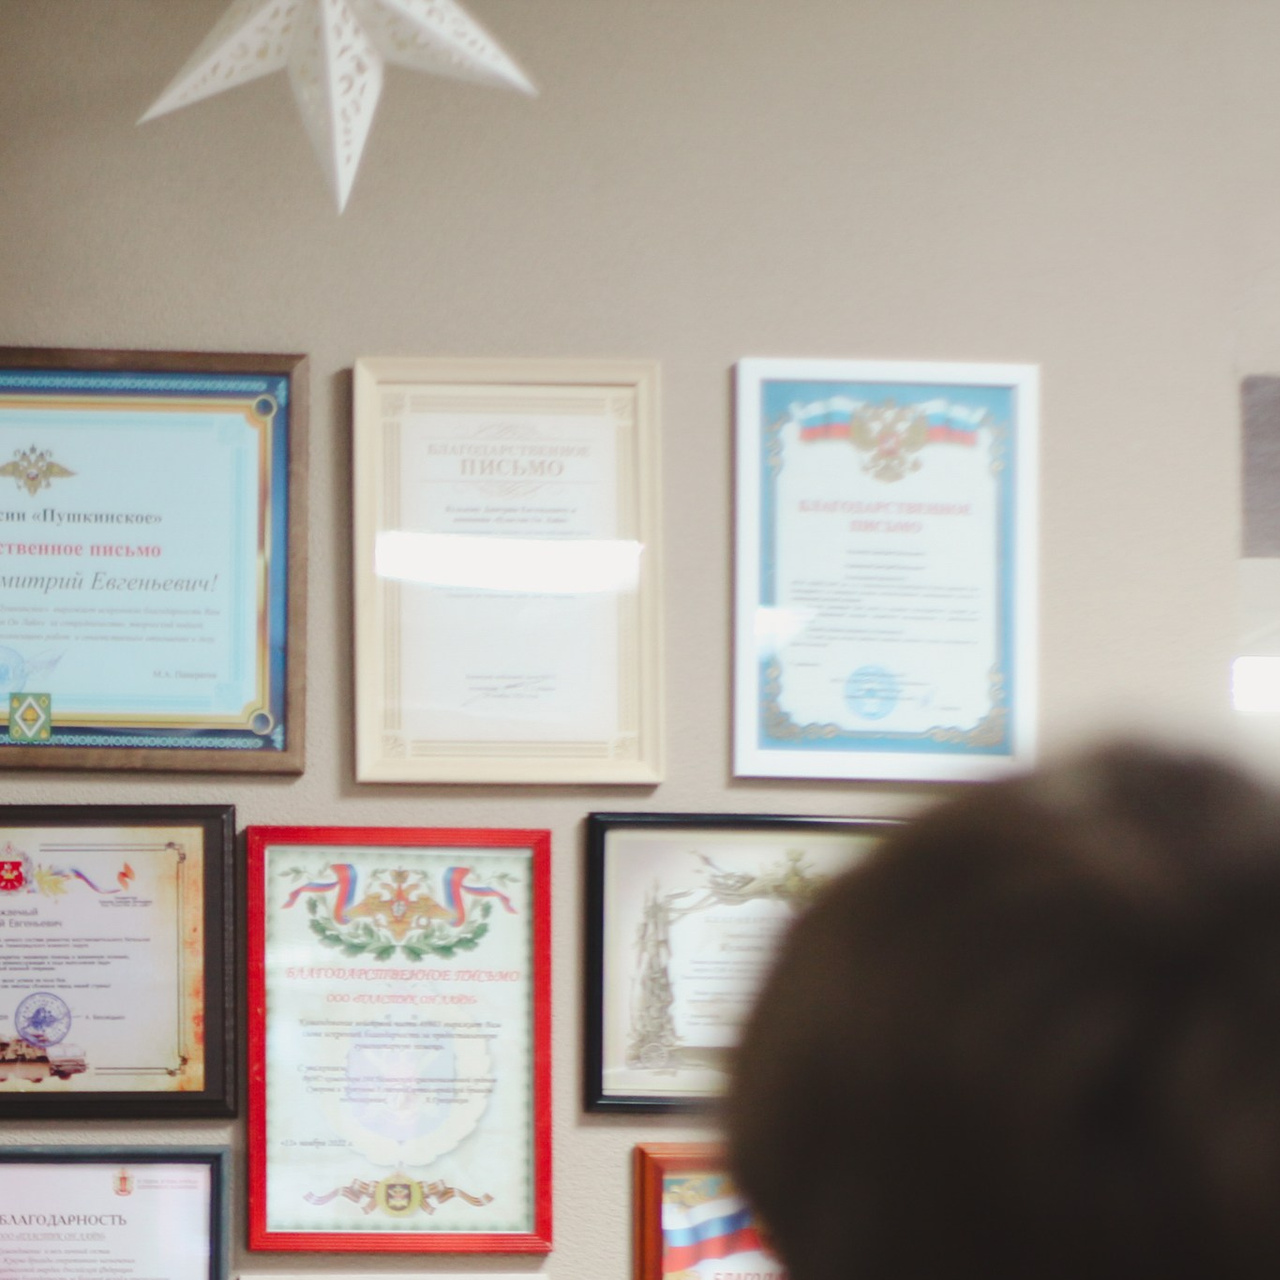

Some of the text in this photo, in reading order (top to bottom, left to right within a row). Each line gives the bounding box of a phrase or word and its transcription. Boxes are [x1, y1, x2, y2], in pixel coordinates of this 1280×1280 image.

[459, 458, 566, 477] ПИСЬМО
[32, 508, 162, 526] «Пушкинское»
[89, 542, 162, 559] письмо
[90, 572, 218, 593] Евгеньевич!
[8, 918, 63, 929] Евгеньевич
[285, 966, 520, 982] БЛАГОДАРСТВЕННОЕ ПИСЬМО
